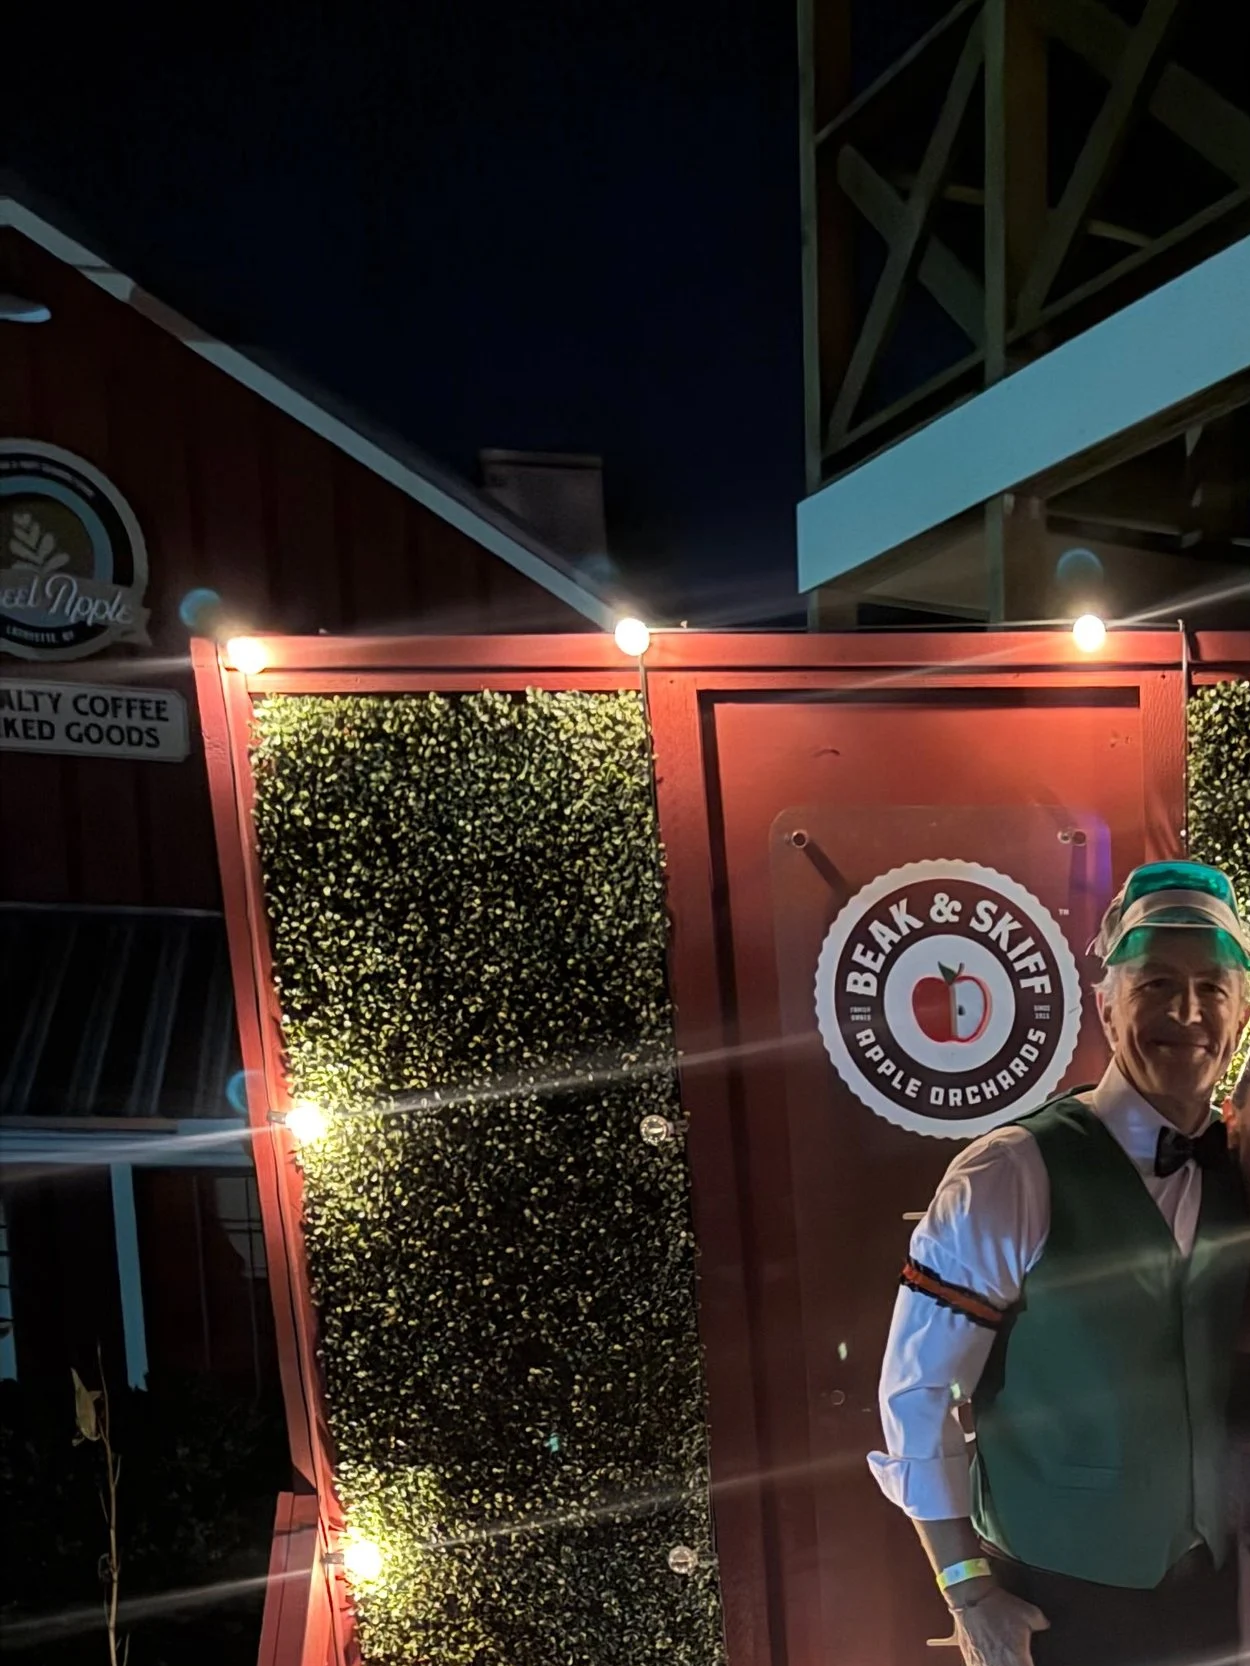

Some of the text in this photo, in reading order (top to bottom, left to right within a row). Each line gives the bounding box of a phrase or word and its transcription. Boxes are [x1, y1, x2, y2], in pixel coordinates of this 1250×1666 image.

[45, 573, 133, 626] Apple
[0, 689, 169, 721] ALTY COFFEE
[2, 717, 160, 748] KED GOODS
[846, 892, 1052, 998] BEAK & SKIFF
[855, 1027, 1047, 1107] APPLE ORCHARDS
